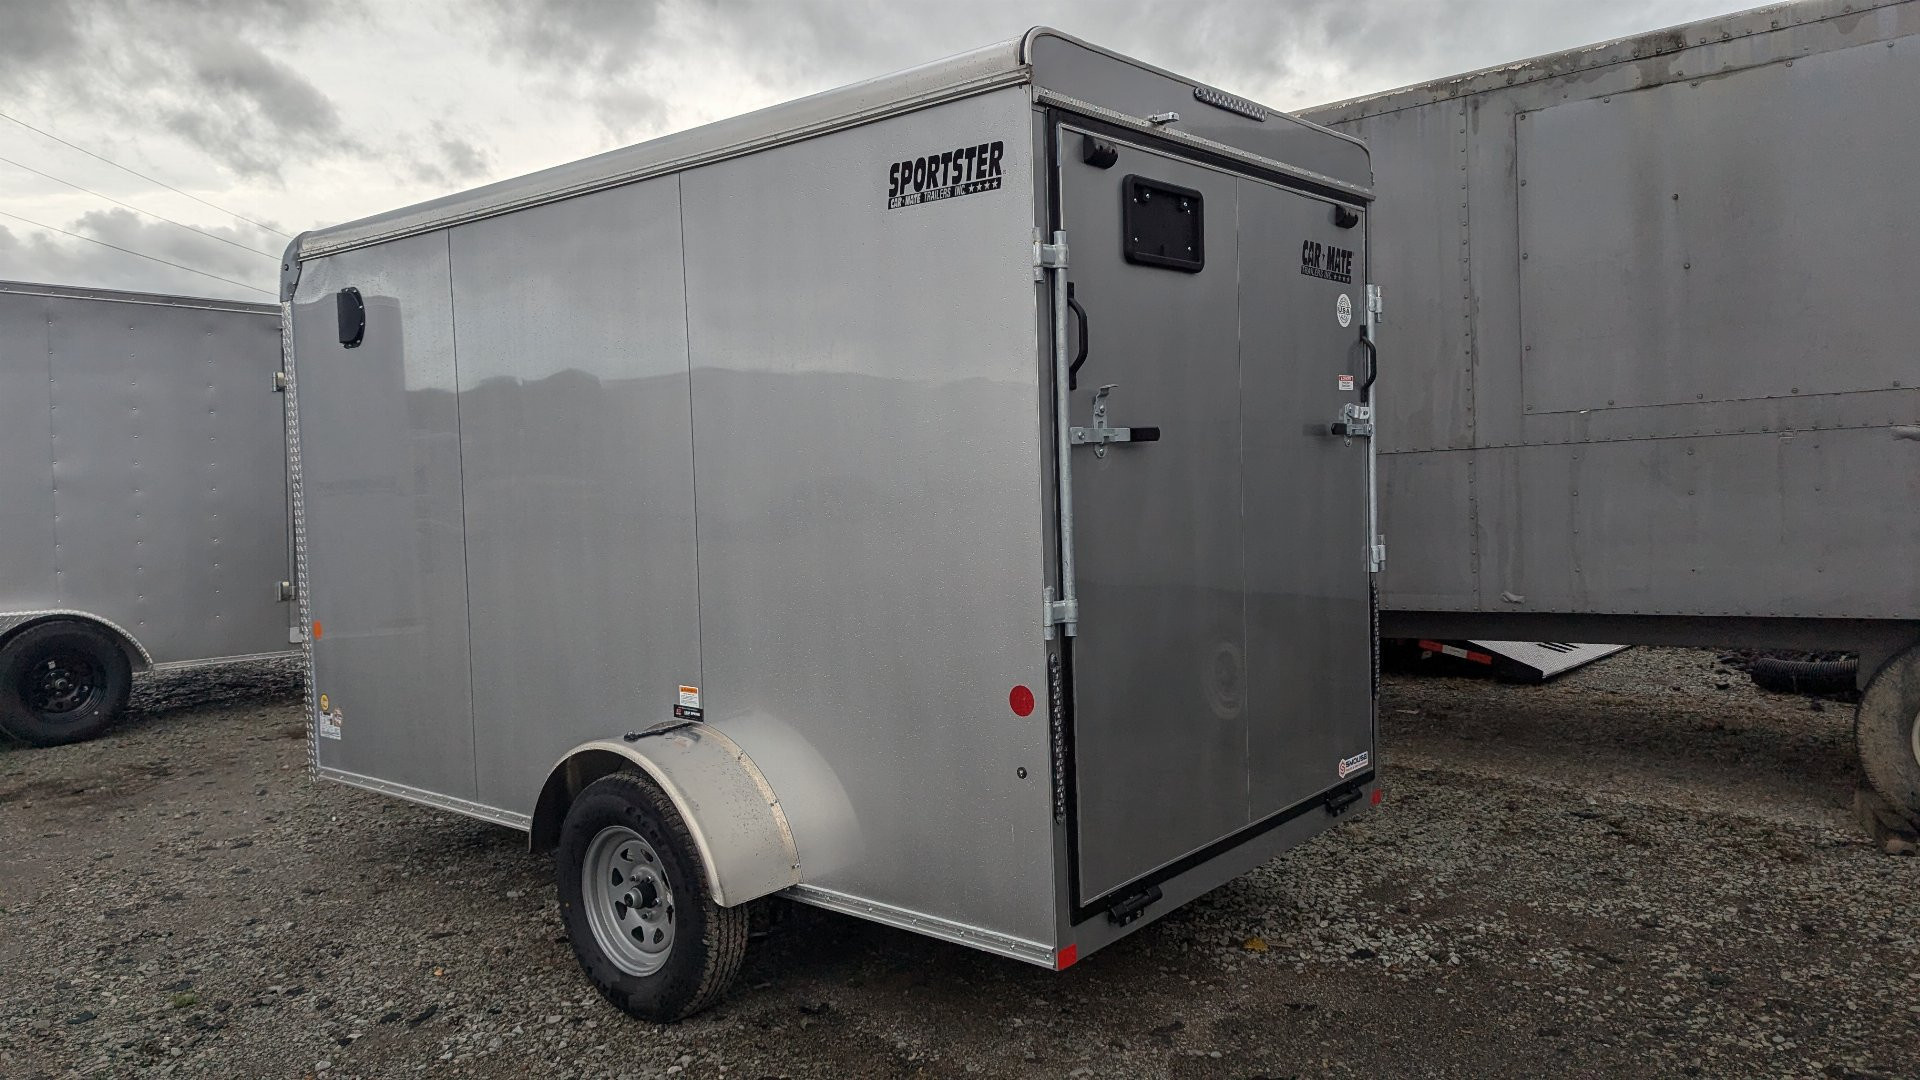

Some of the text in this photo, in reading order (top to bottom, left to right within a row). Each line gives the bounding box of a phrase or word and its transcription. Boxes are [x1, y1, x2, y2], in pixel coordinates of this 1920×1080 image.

[888, 141, 1004, 198] SPORTSTER
[924, 188, 951, 202] TRAILERS
[1327, 246, 1352, 274] MATE
